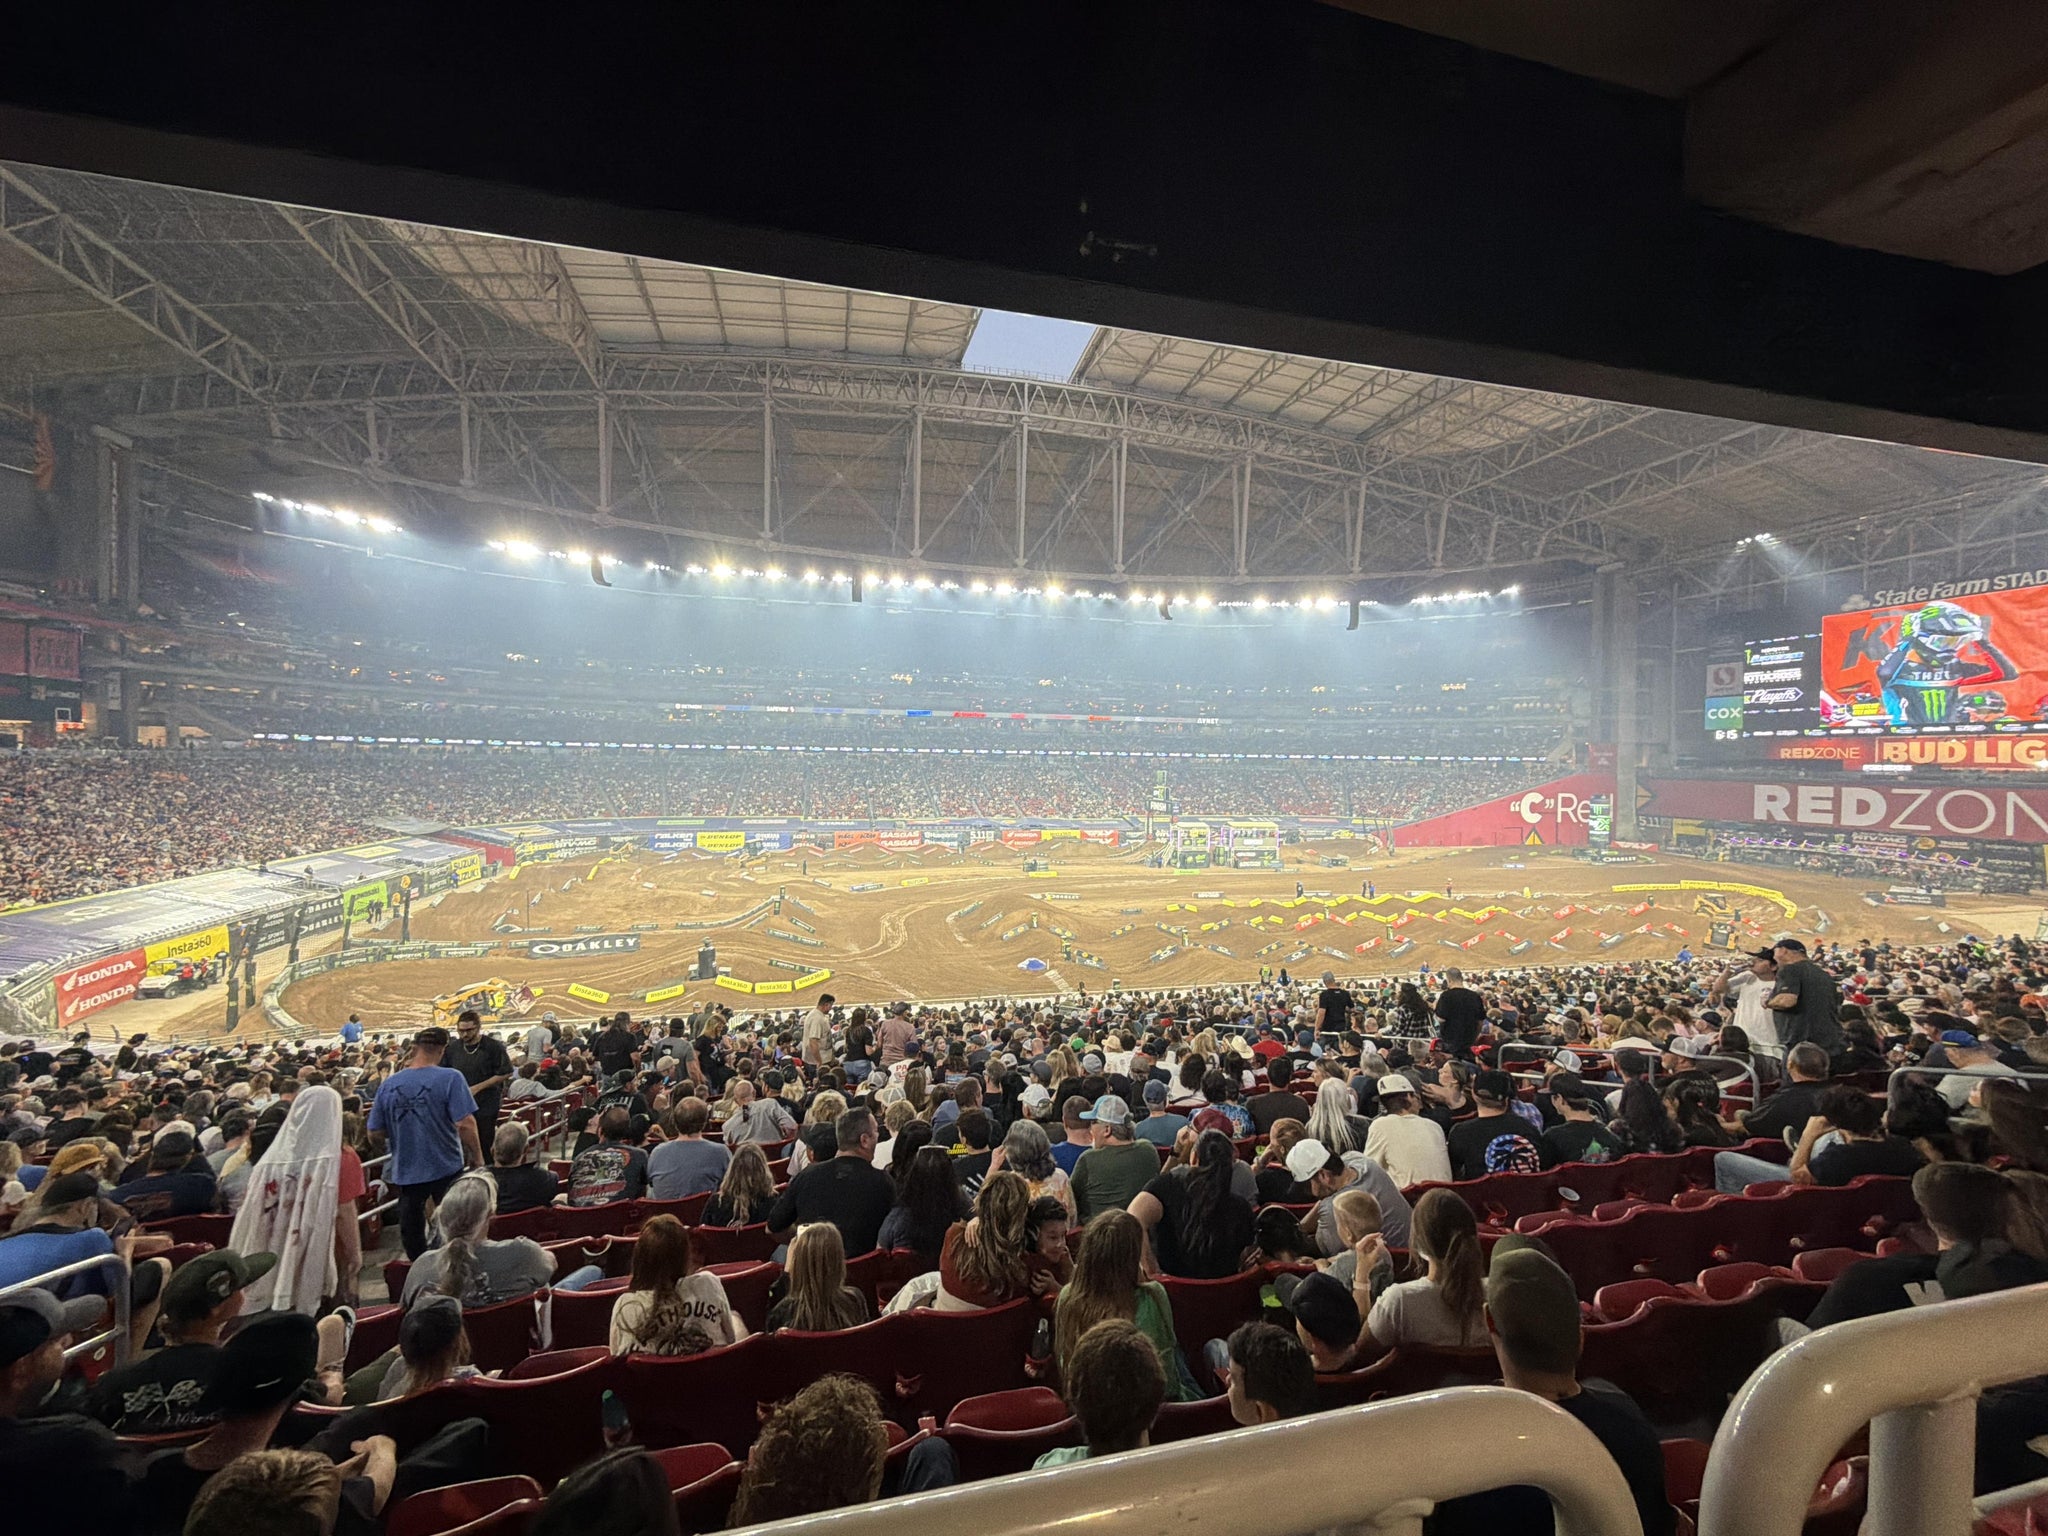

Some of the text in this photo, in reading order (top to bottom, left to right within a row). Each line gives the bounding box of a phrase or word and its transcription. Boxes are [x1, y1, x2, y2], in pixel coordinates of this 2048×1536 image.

[1707, 707, 1742, 720] COX
[1780, 747, 1861, 759] REDZONE
[1882, 740, 1968, 764] BUD
[453, 858, 479, 871] SUZUKI
[562, 938, 638, 952] OAKLEY
[78, 960, 137, 987] HONDA
[759, 983, 788, 991] Insta360
[79, 983, 136, 1012] HONDA
